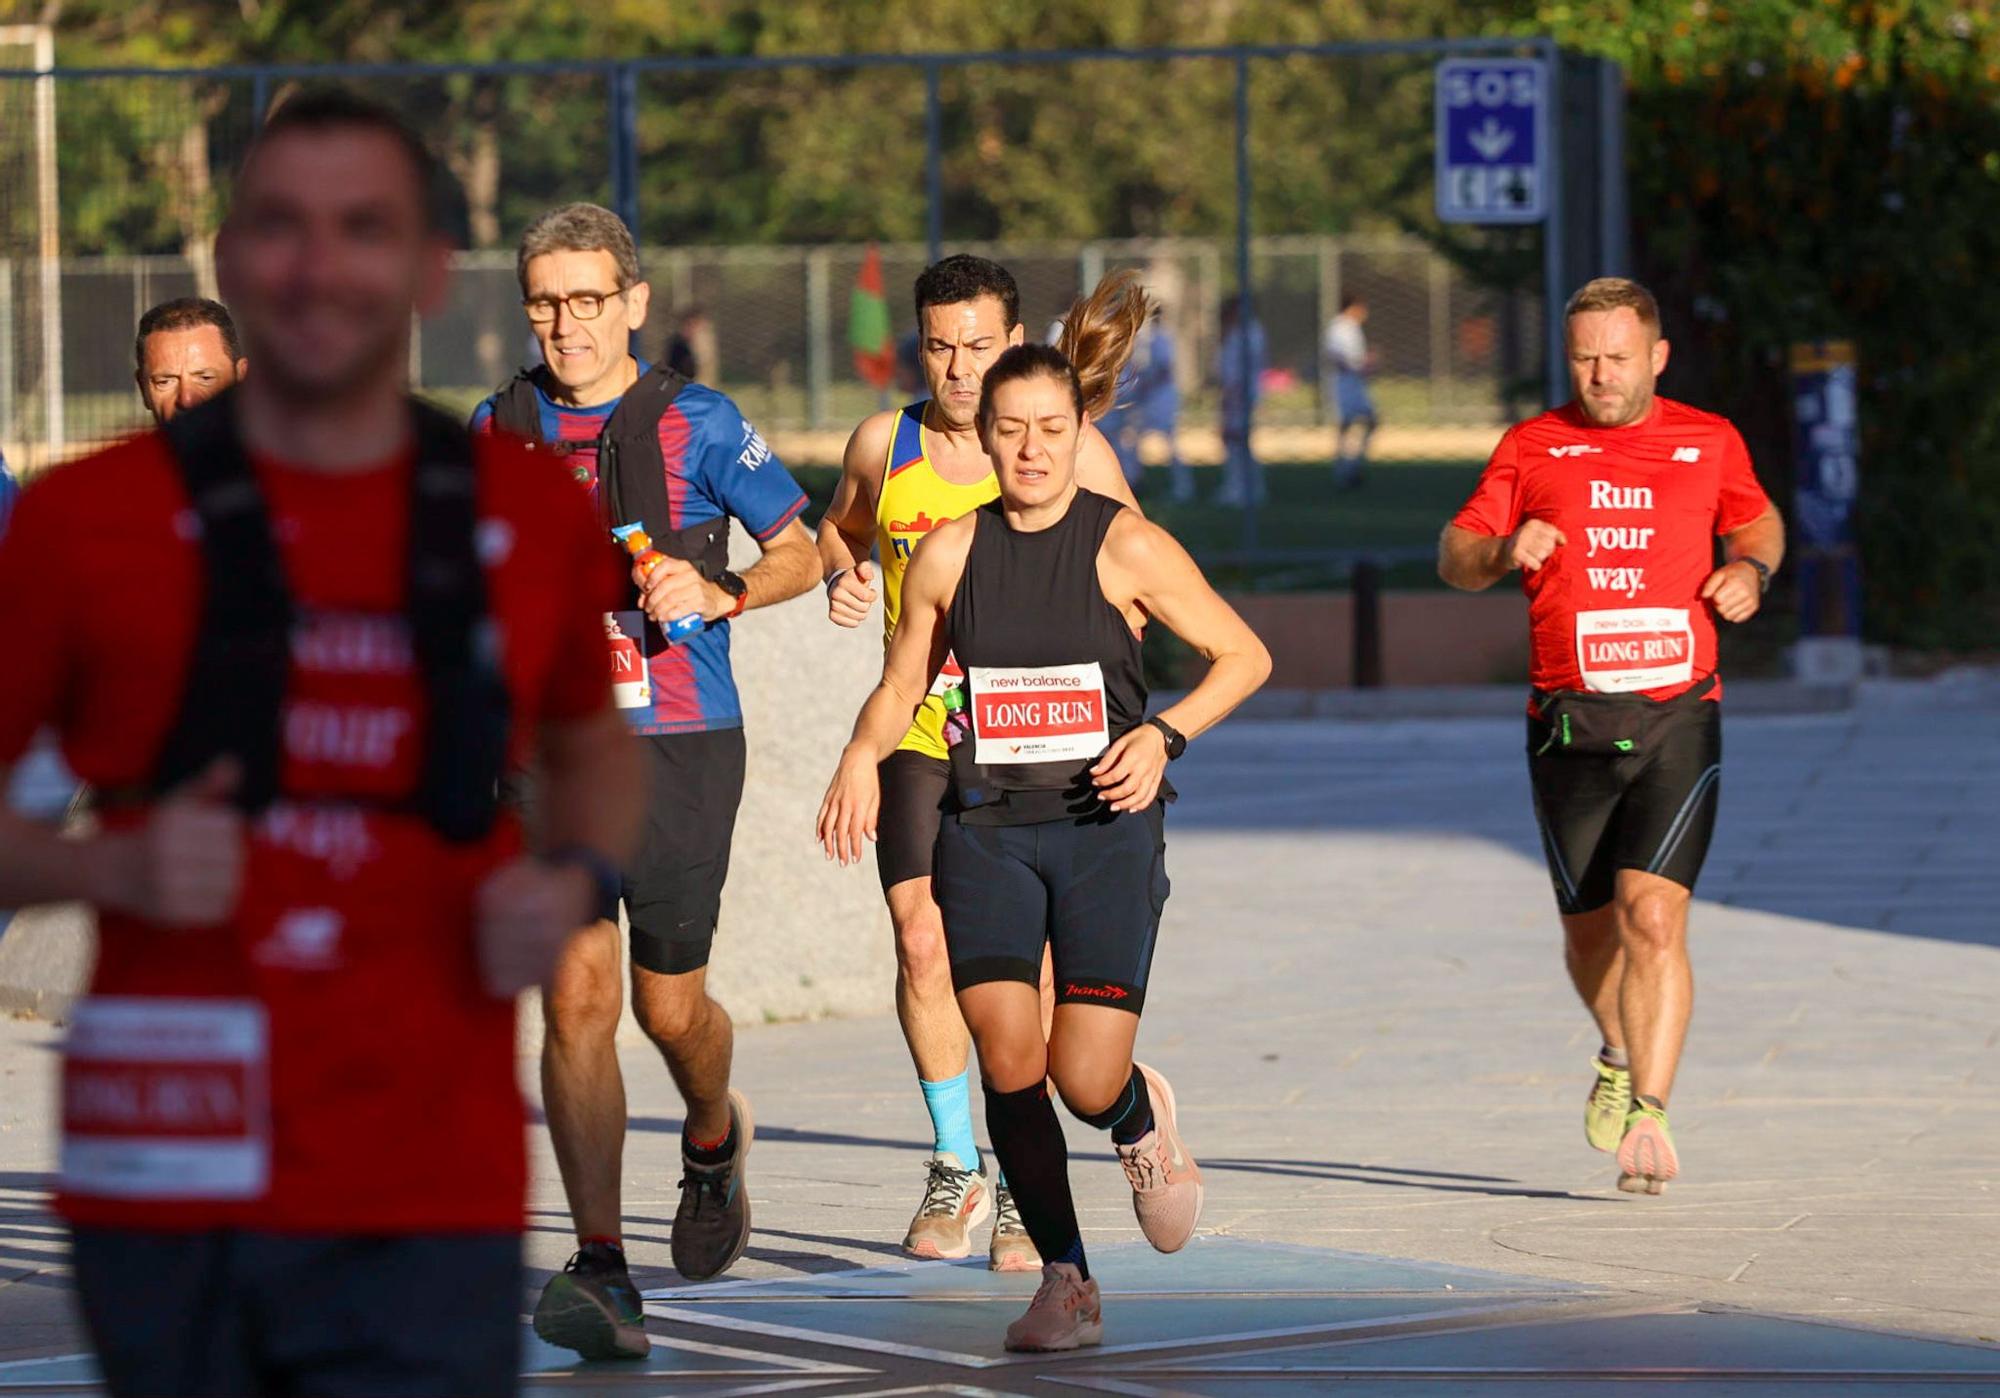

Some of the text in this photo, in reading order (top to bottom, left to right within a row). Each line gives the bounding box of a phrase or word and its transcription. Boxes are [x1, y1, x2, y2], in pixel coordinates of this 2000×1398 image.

[1446, 72, 1537, 107] SOS
[1589, 480, 1653, 509] Run
[1585, 526, 1655, 557] your
[1586, 567, 1646, 598] way.
[1588, 637, 1684, 663] LONG RUN
[990, 675, 1081, 688] new balance
[985, 701, 1093, 728] LONG RUN
